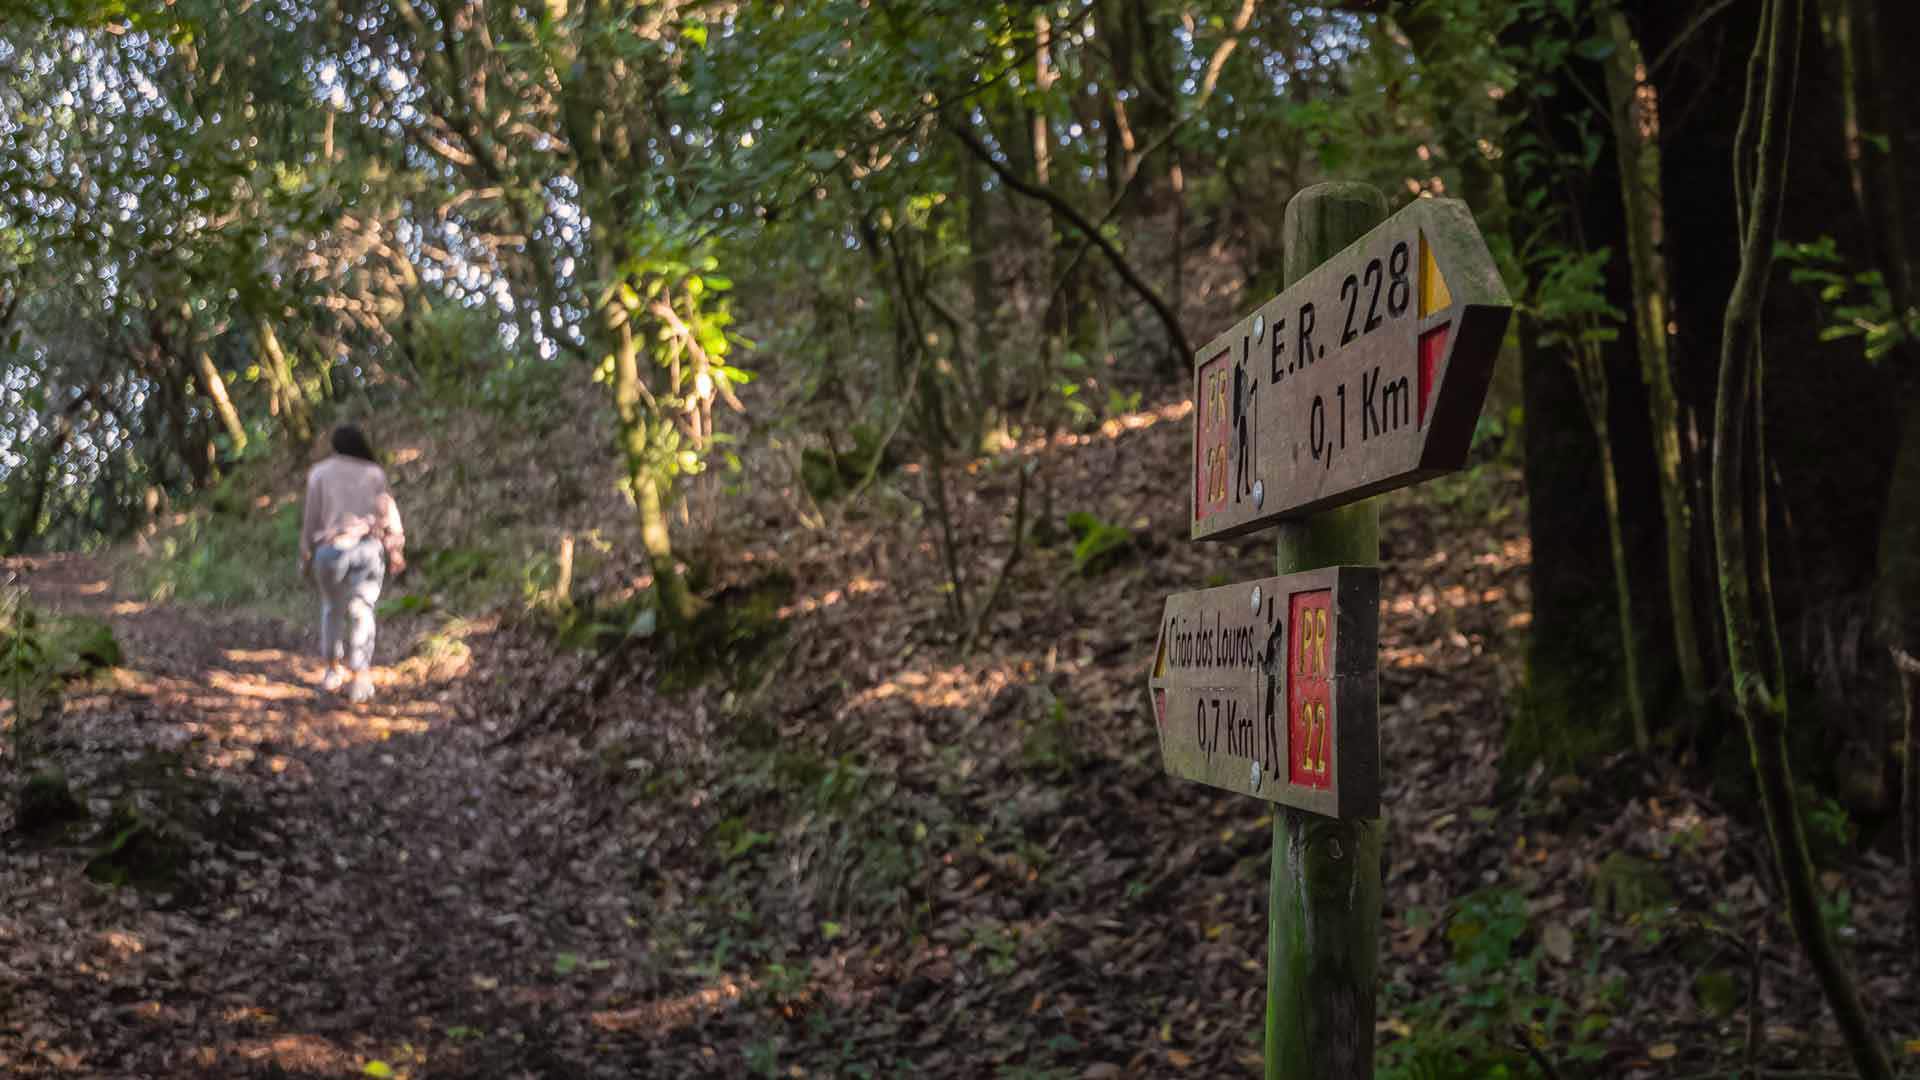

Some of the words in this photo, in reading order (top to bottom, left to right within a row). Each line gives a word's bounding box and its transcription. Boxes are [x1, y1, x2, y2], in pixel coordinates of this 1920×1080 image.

[1271, 301, 1325, 385] E.R.
[1339, 240, 1411, 349] 228
[1310, 383, 1346, 470] 0,1
[1361, 365, 1409, 441] Km
[1196, 610, 1213, 668] dos
[1216, 610, 1254, 668] Louros
[1300, 608, 1327, 673] PR
[1197, 697, 1220, 763] 0,7
[1227, 700, 1255, 759] Km
[1302, 703, 1326, 773] 22
